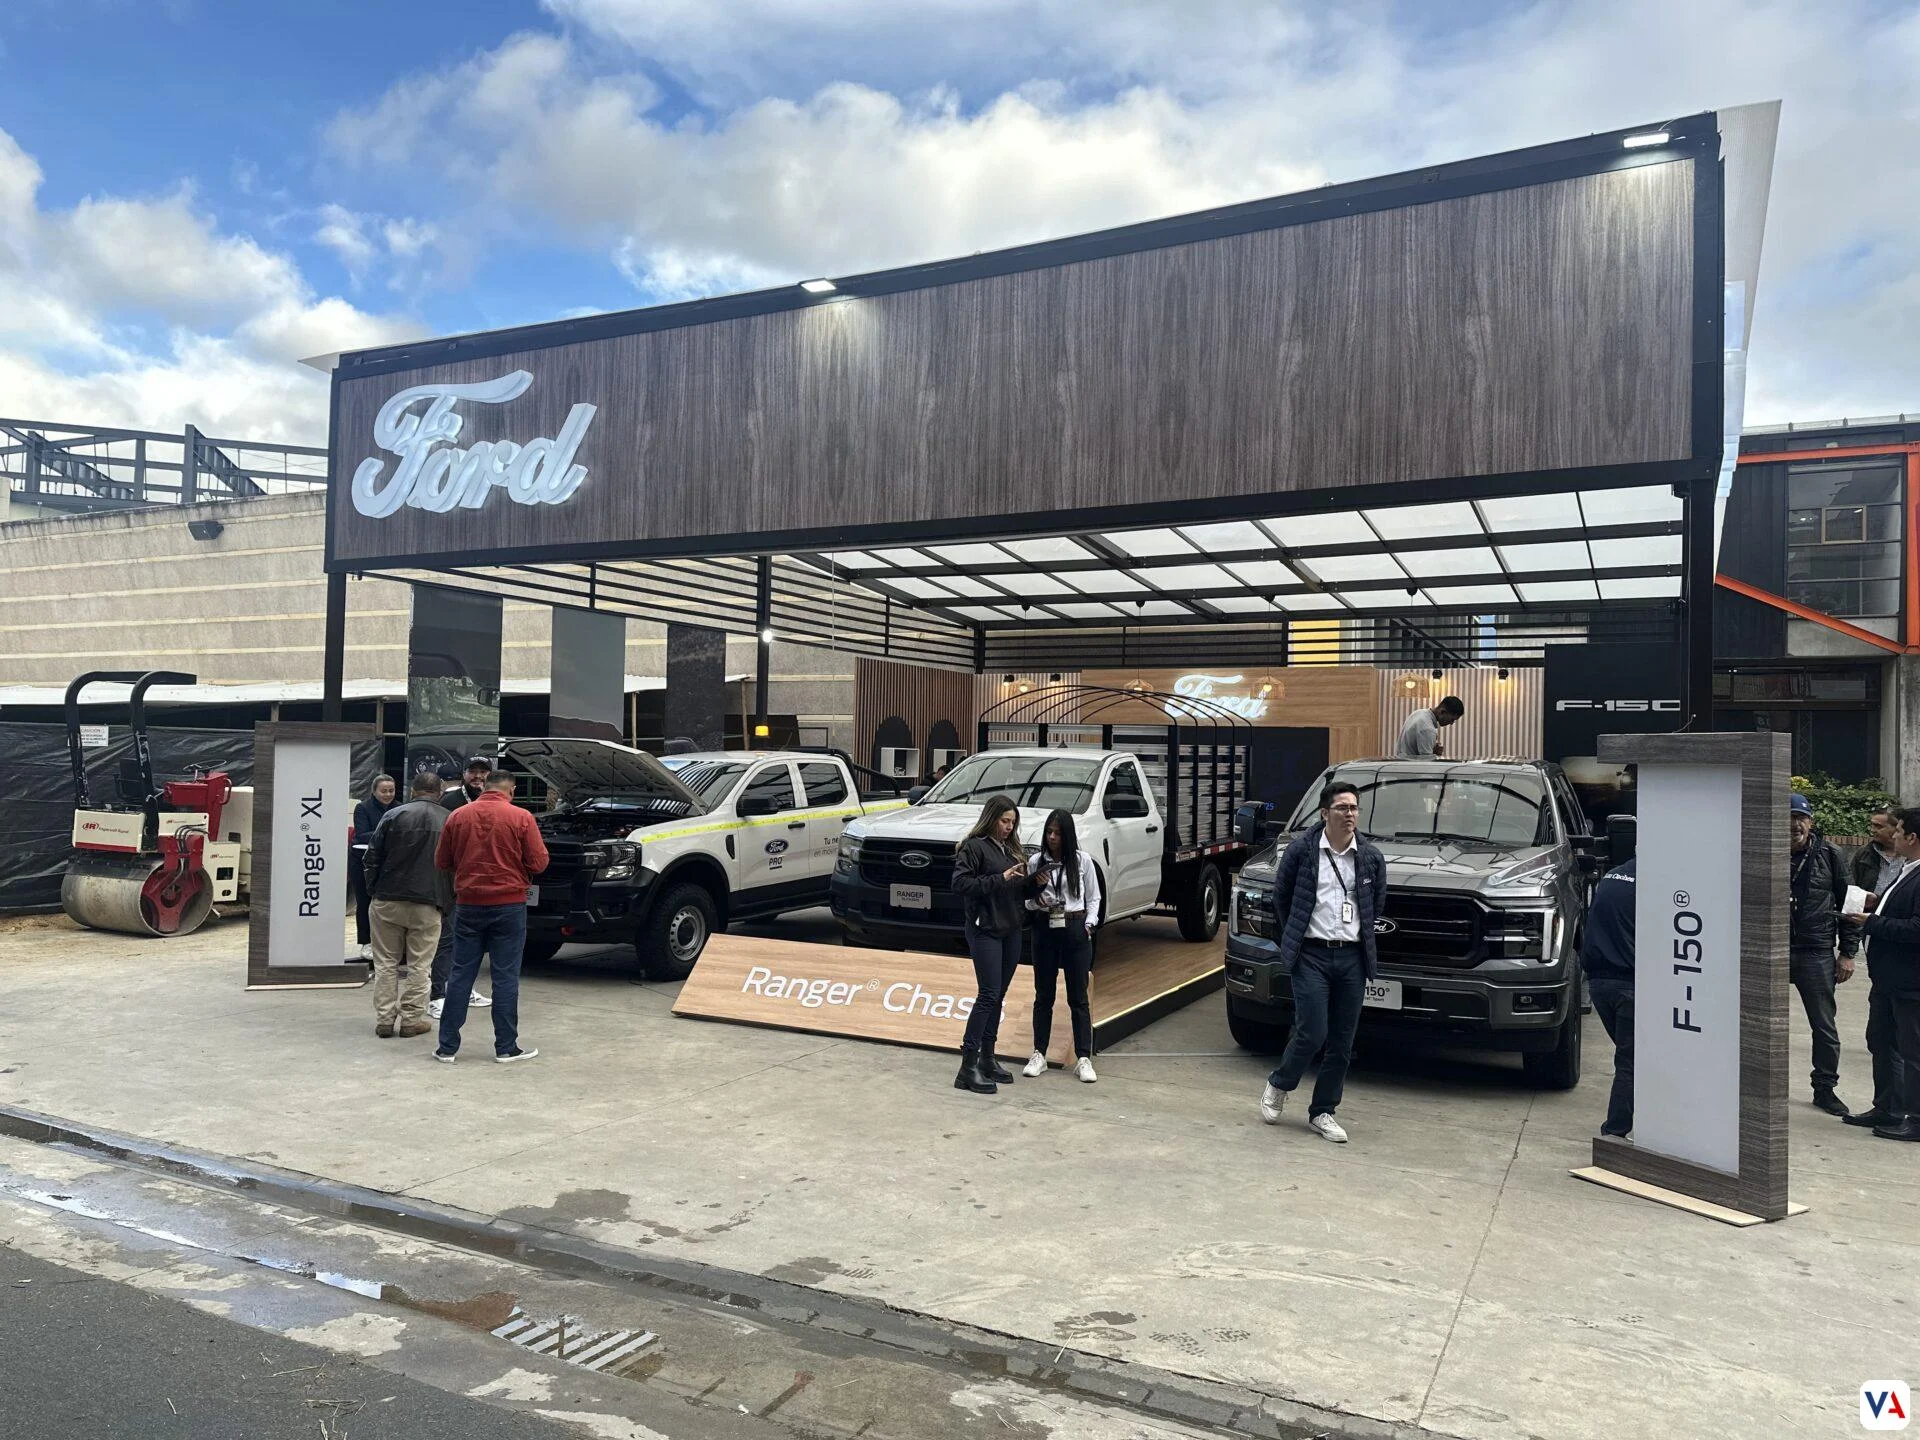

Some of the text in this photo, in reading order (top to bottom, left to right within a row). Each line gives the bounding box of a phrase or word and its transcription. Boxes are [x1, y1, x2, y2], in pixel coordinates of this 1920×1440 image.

[352, 369, 598, 519] Ford
[1164, 674, 1268, 718] Ford
[301, 788, 323, 819] XL
[767, 840, 787, 853] Ford
[769, 857, 783, 866] PRO
